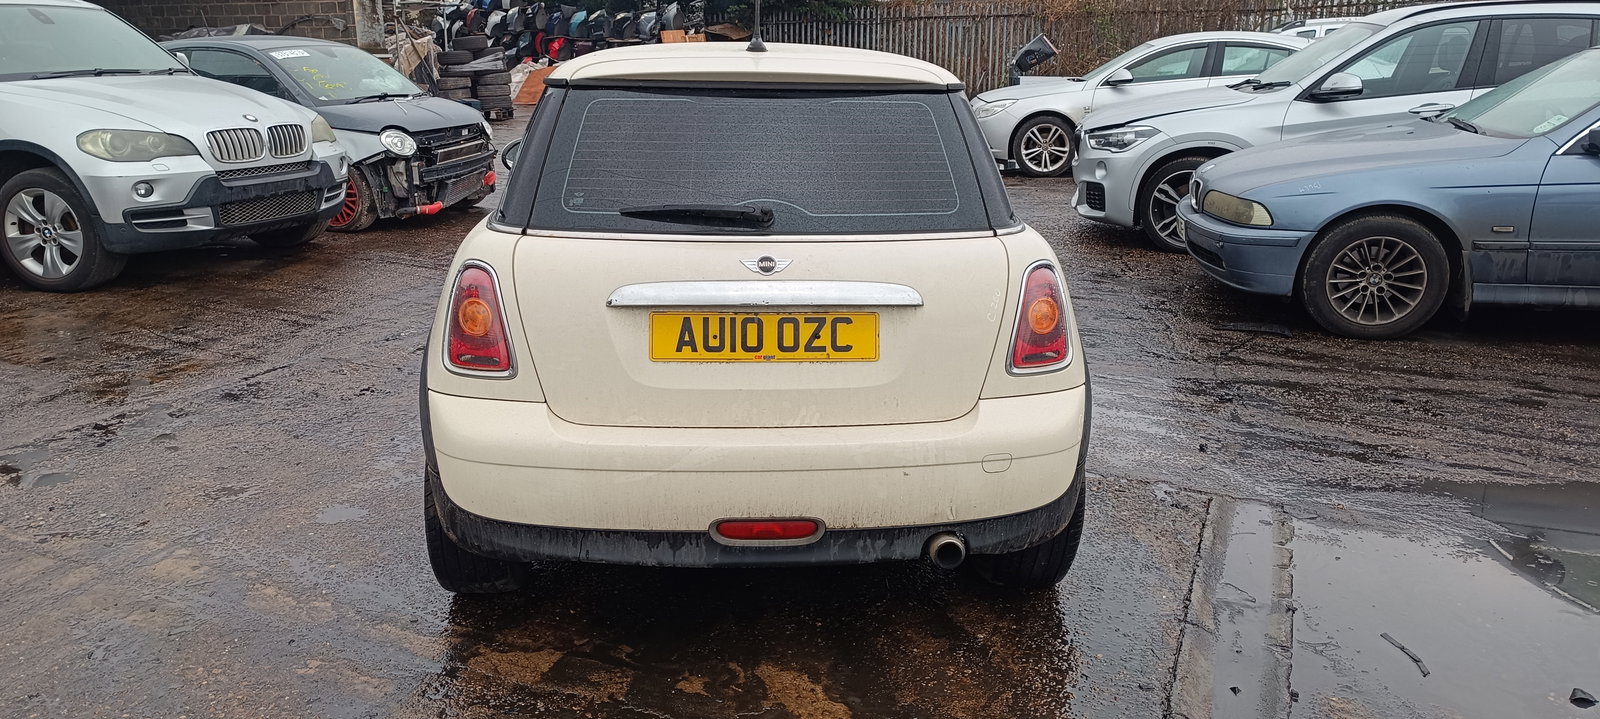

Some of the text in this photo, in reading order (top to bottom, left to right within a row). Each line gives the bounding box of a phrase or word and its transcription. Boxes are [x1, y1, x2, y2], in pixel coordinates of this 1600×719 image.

[758, 260, 776, 268] MINI
[675, 316, 853, 353] AU10 OZC
